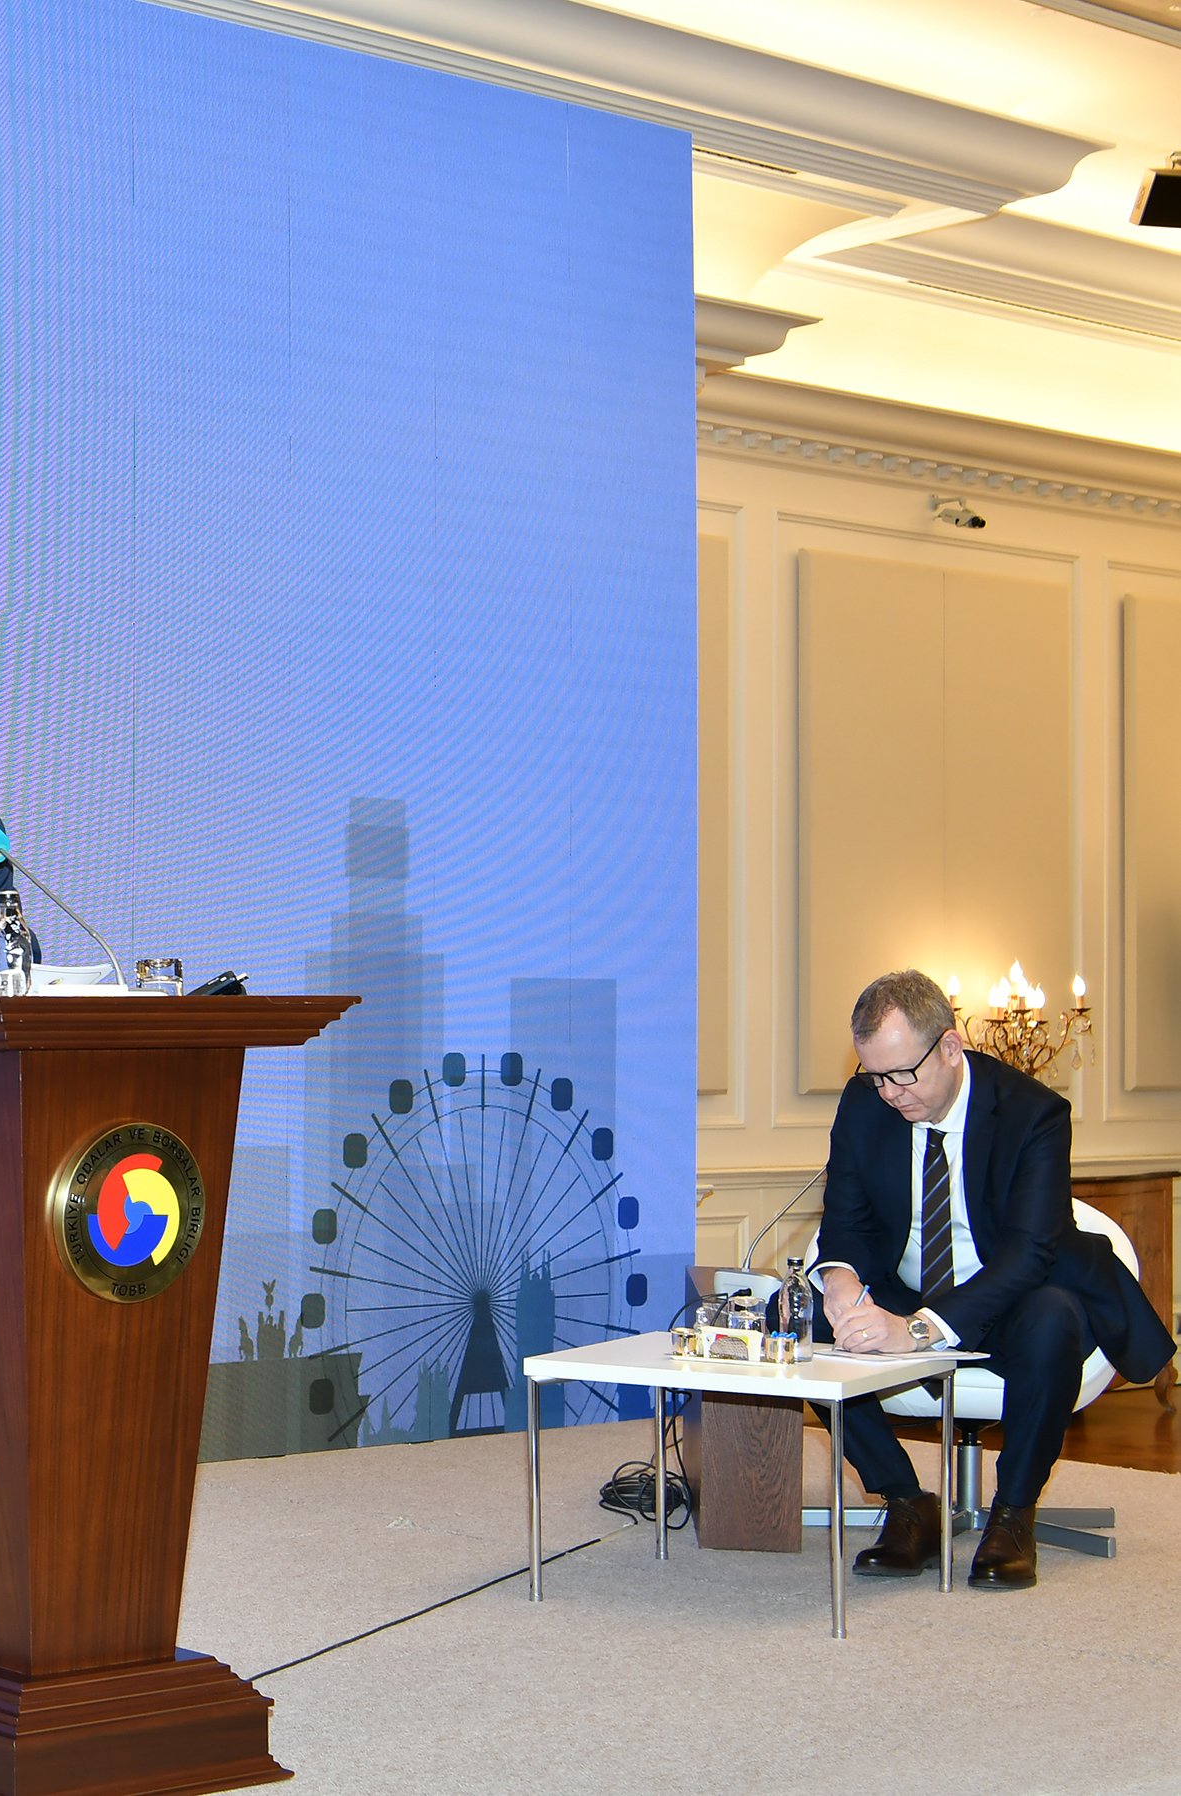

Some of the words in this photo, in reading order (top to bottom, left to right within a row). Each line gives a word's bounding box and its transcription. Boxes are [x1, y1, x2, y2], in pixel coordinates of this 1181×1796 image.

[76, 1132, 123, 1185] ODALAR
[128, 1127, 146, 1140] VE
[152, 1130, 202, 1198] BORSALAR
[111, 1282, 147, 1297] TOBB
